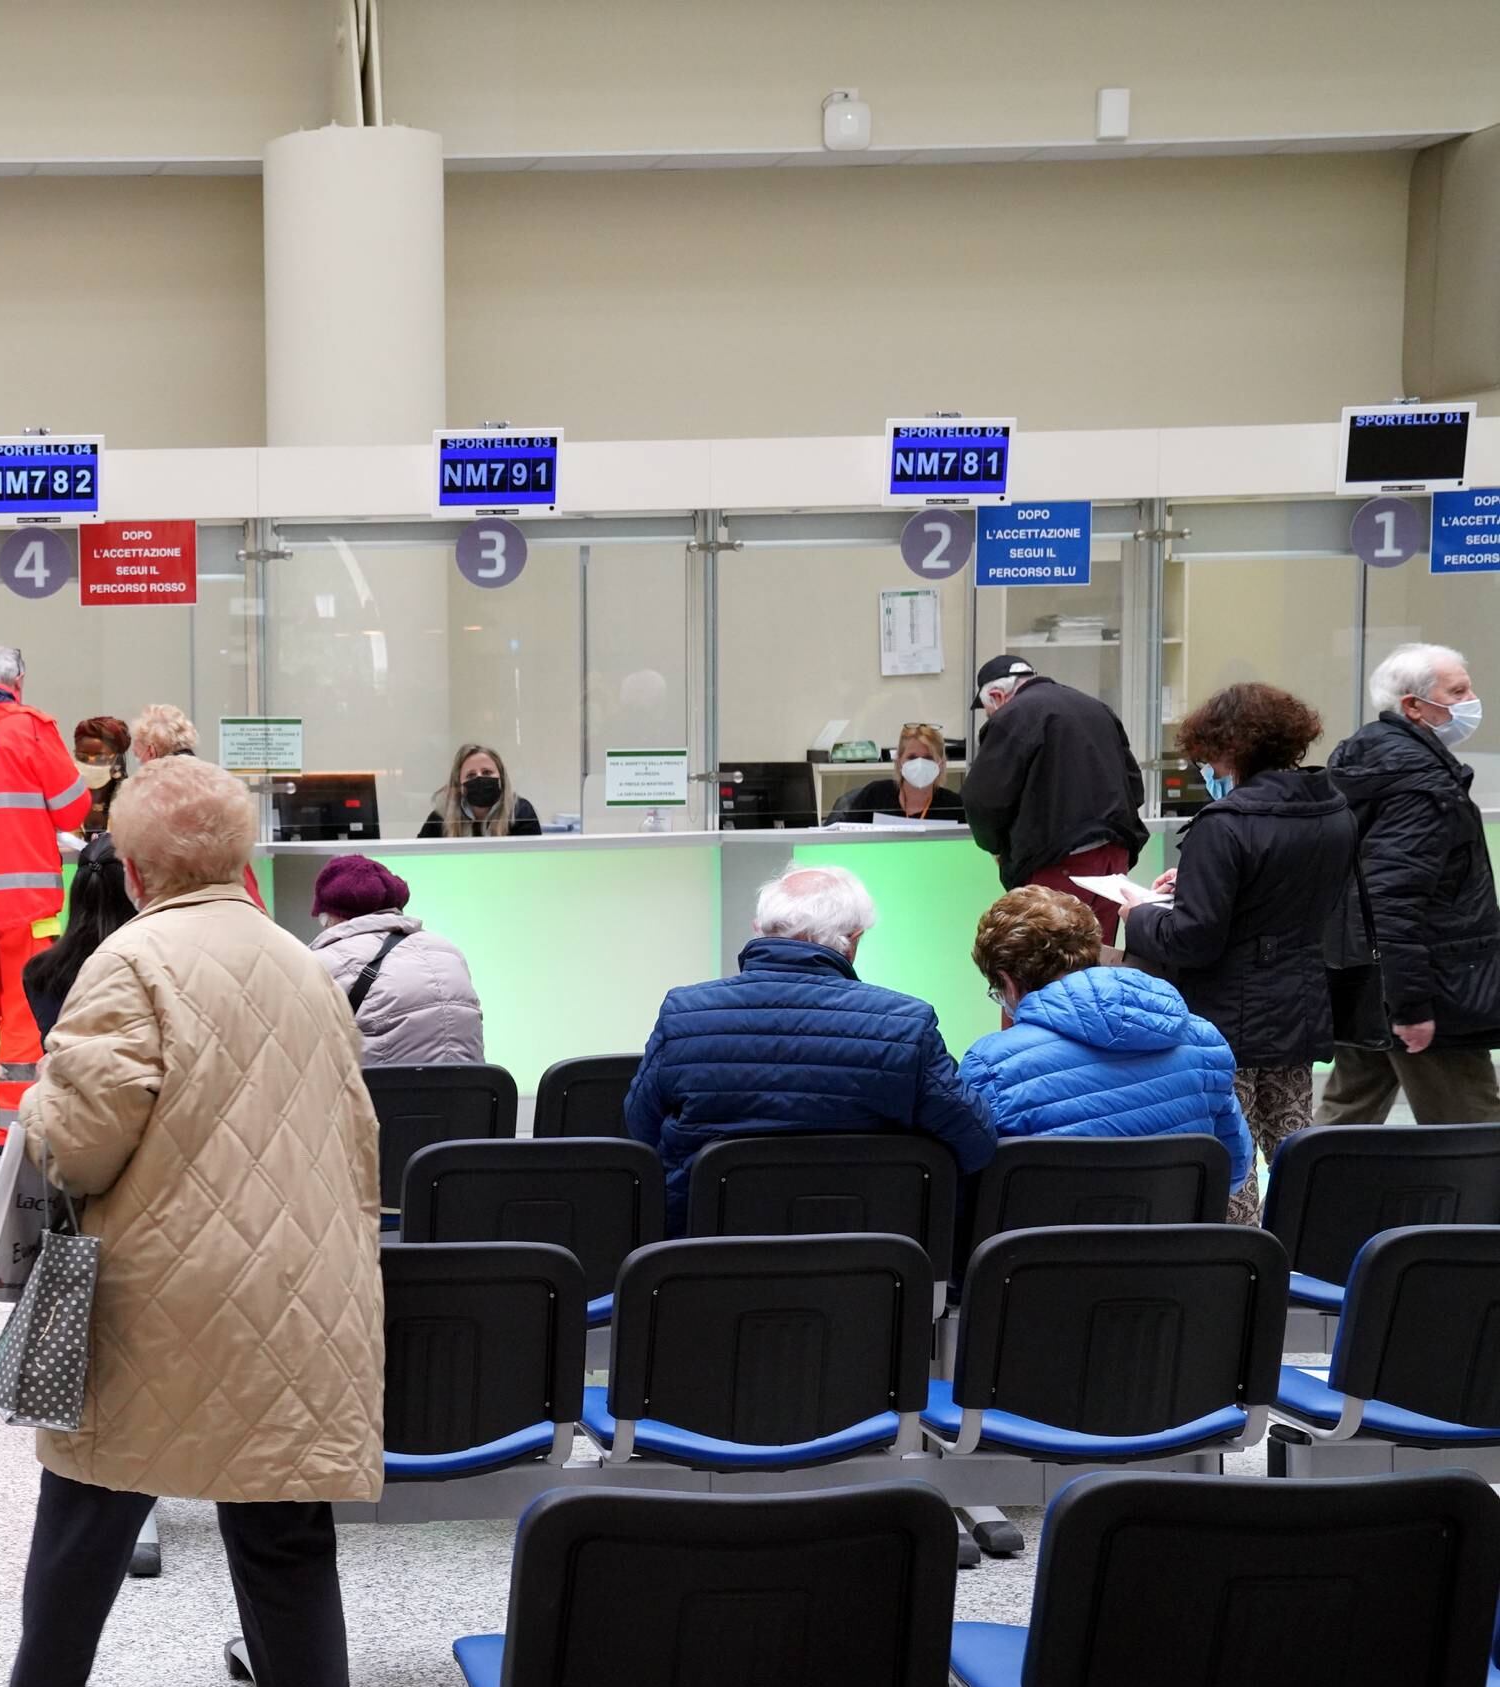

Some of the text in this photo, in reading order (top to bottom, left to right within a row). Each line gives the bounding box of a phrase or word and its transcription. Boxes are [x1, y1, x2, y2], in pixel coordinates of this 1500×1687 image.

[1356, 413, 1462, 427] SPORTELLO 01
[899, 427, 1004, 438] SPORTELLO 02
[447, 438, 551, 449] SPORTELLO 03
[73, 445, 92, 456] 04
[895, 452, 999, 476] NM781
[444, 462, 547, 487] NM791
[1474, 496, 1500, 507] DOP
[1018, 510, 1050, 520] DOPO
[122, 531, 152, 541] DOPO
[986, 529, 1081, 540] L'ACCETTAZIONE
[1374, 511, 1403, 558] 1
[922, 523, 952, 570] 2
[94, 548, 181, 559] L'ACCETTAZIONE
[478, 530, 507, 579] 3
[1010, 548, 1056, 558] SEGUI IL
[14, 541, 51, 588] 4
[1444, 553, 1500, 565] PERCORS
[116, 566, 159, 575] SEGUI IL
[989, 566, 1076, 578] PERCORSO BLU
[90, 583, 186, 594] PERCORSO ROSSO
